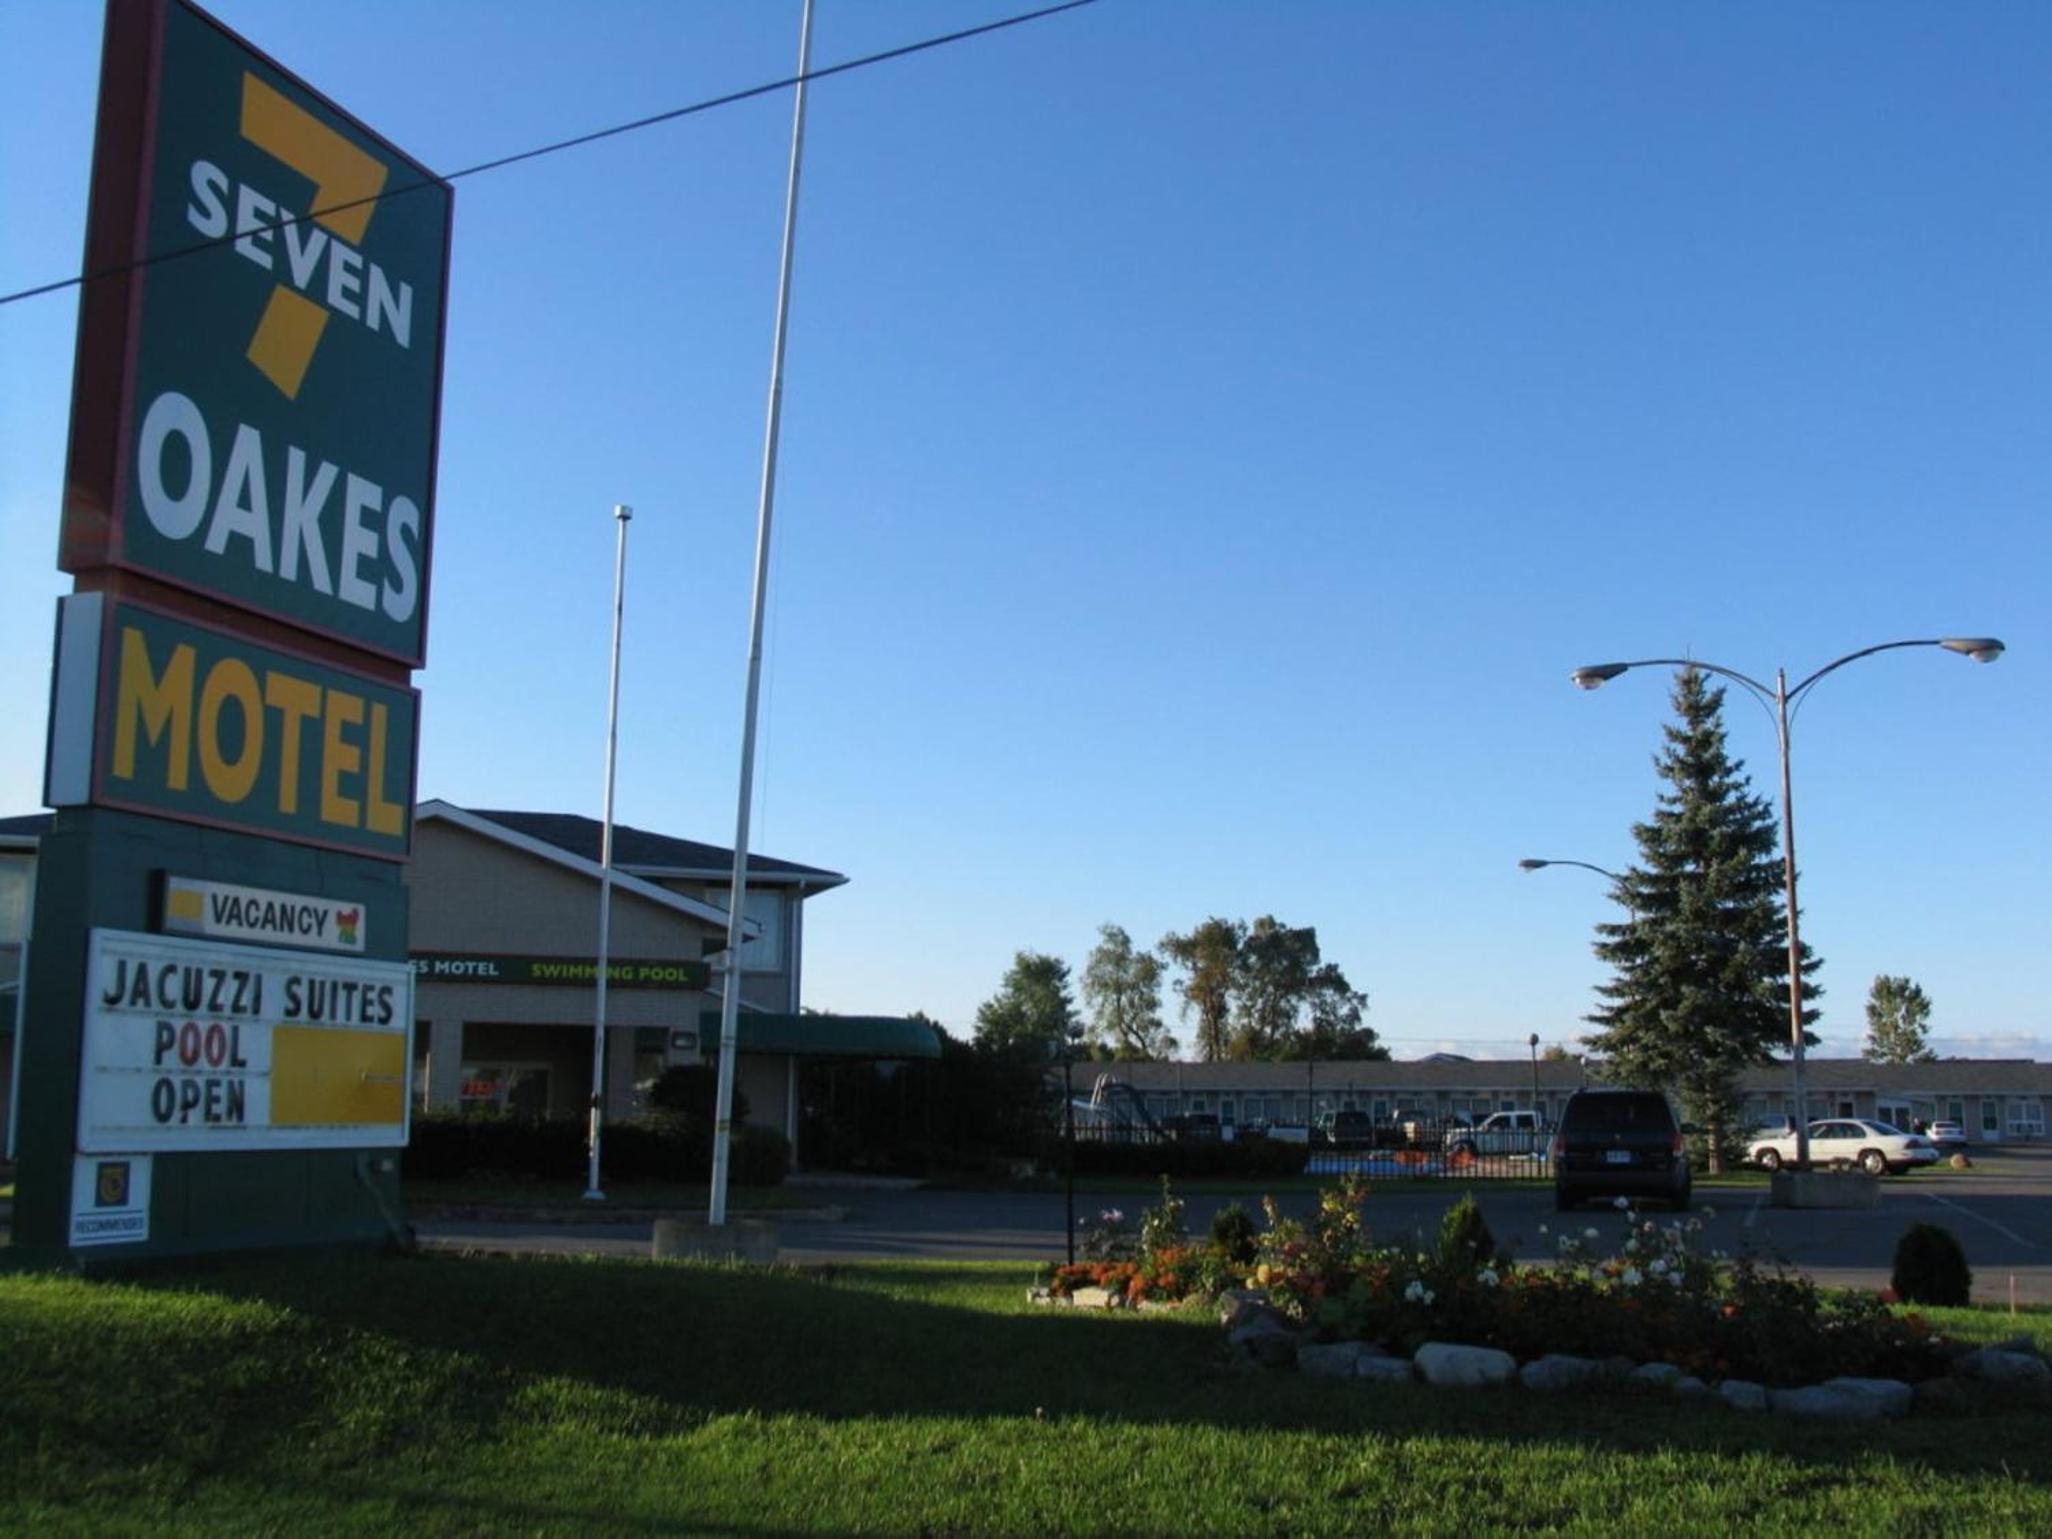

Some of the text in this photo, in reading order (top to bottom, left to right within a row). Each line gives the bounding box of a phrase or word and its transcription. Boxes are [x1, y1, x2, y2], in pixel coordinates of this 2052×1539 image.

[187, 159, 414, 350] SEVEN
[138, 391, 421, 624] OAKES
[112, 626, 404, 837] MOTEL
[210, 892, 329, 938] VACANCY
[103, 959, 394, 1026] JACUZZI SUITES
[434, 960, 500, 977] MOTEL
[531, 962, 689, 982] SWIMMNG POOL
[154, 1020, 247, 1069] POOL
[151, 1077, 246, 1125] OPEN
